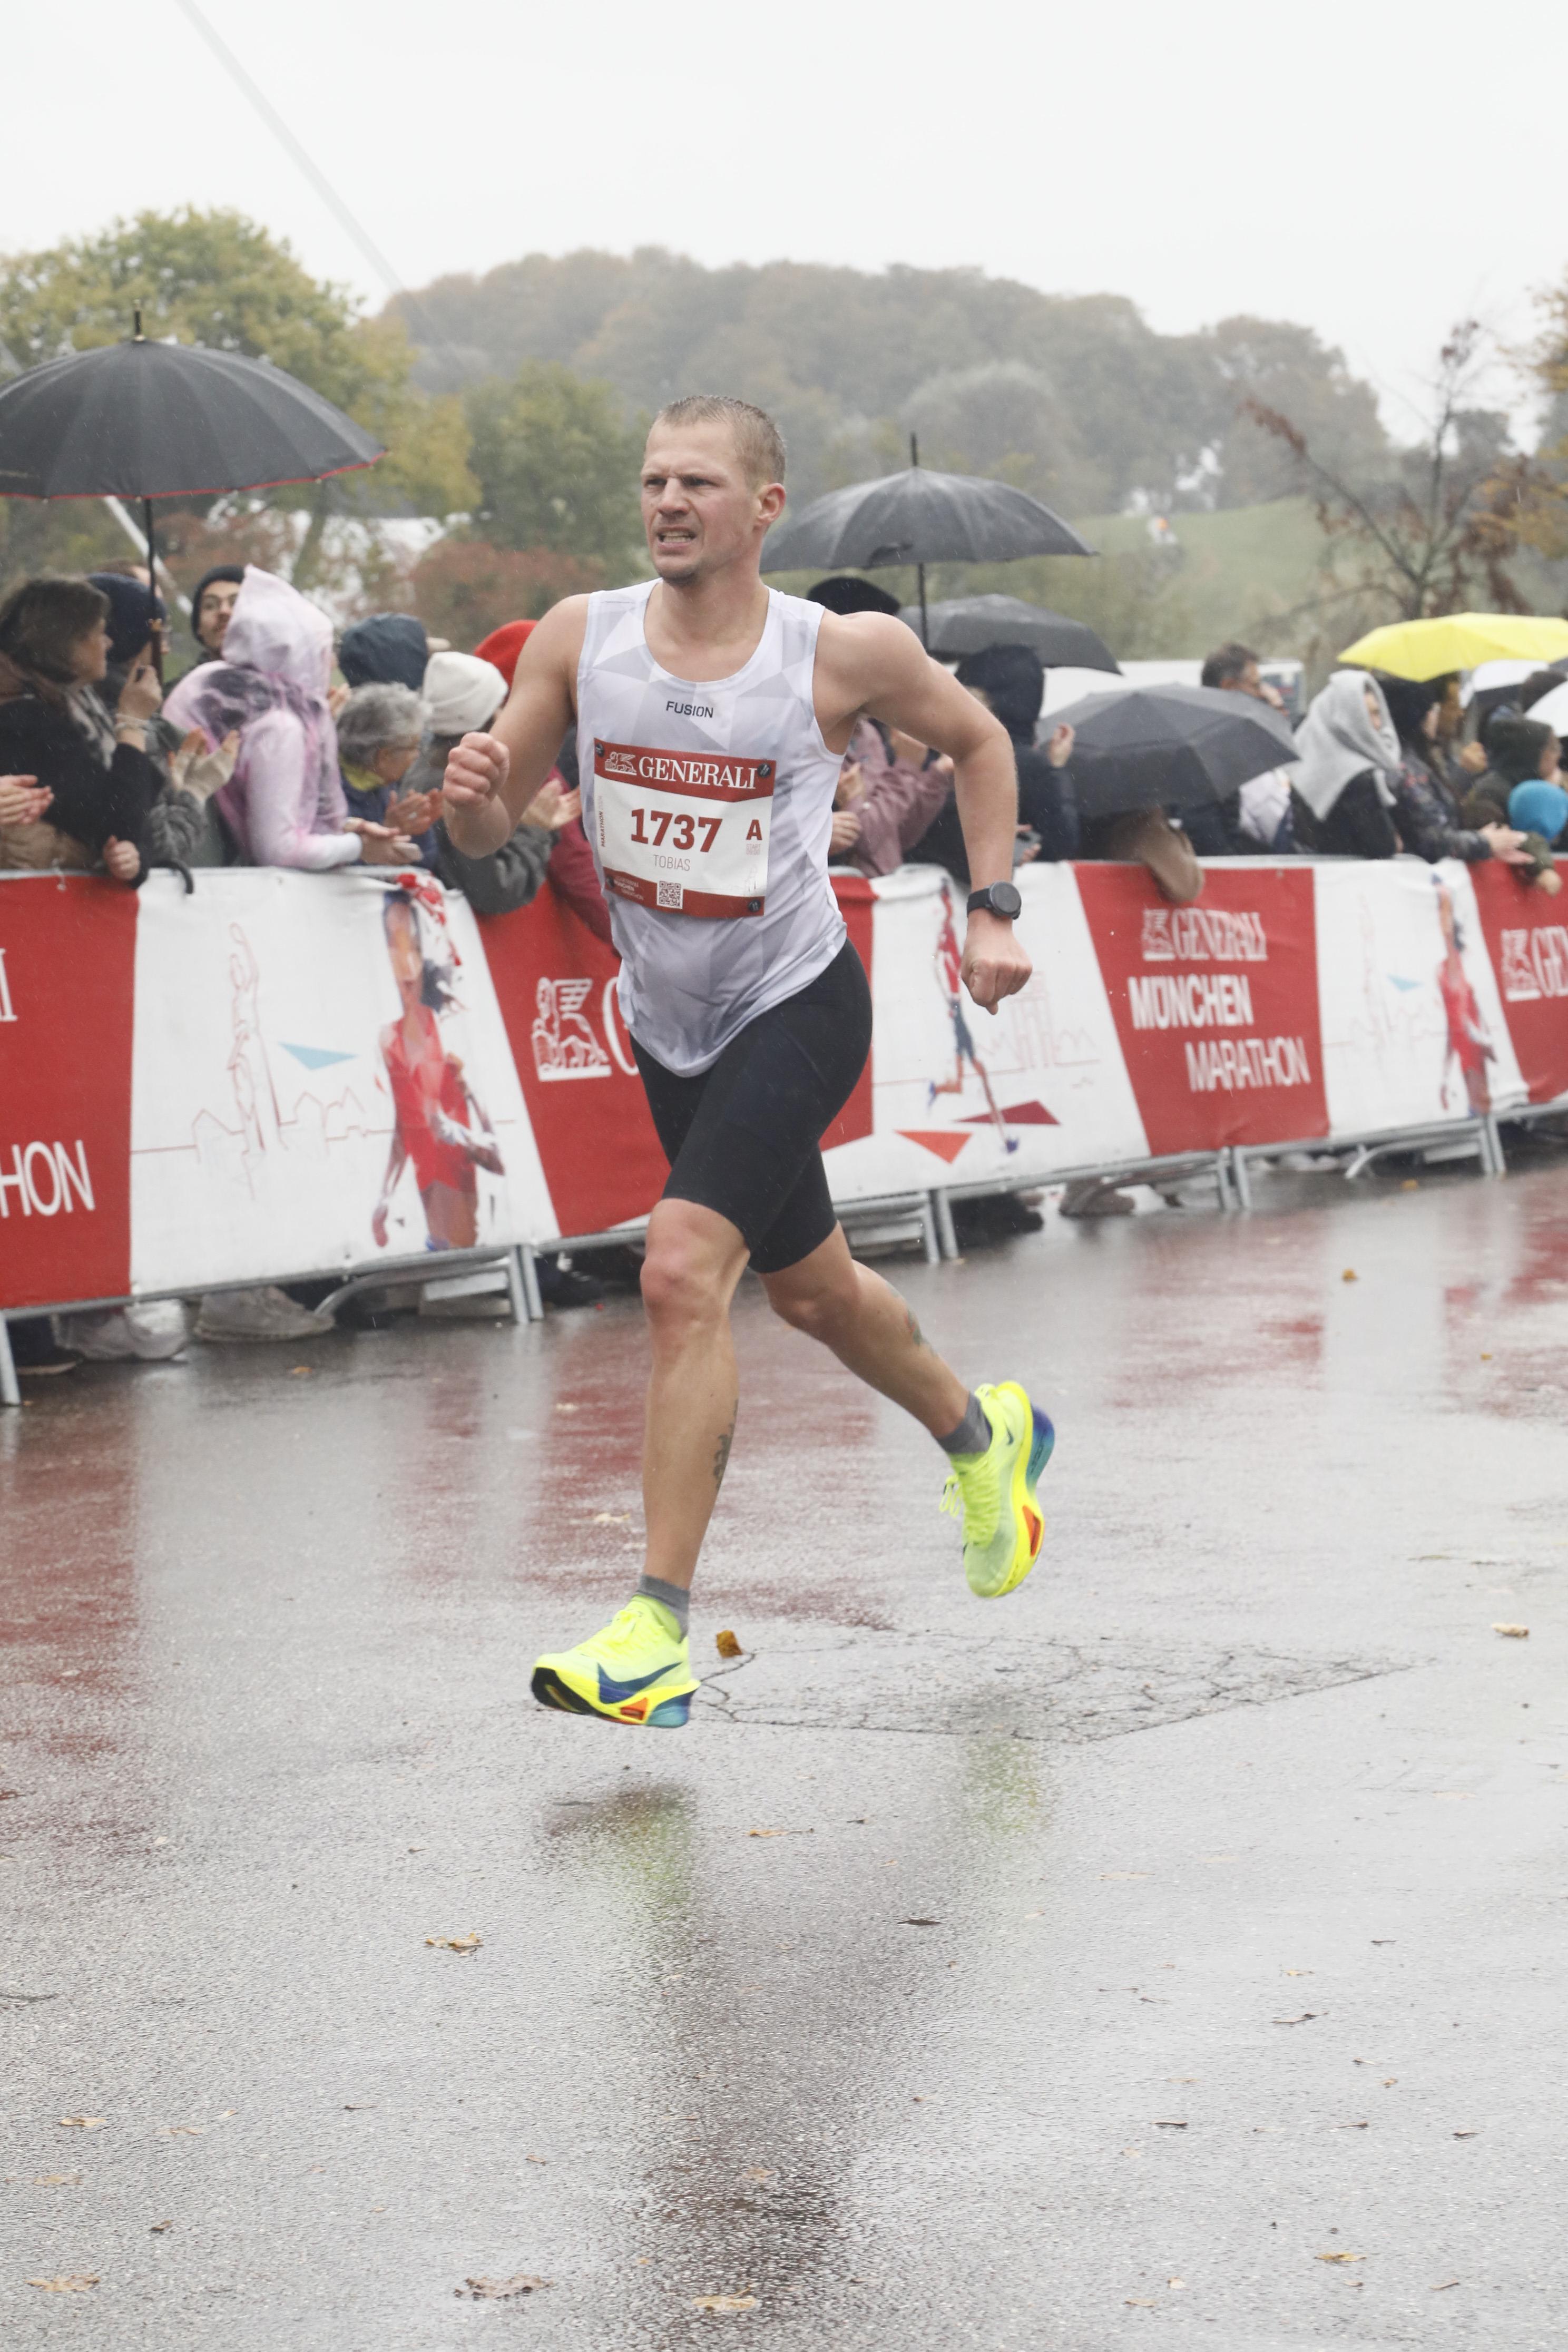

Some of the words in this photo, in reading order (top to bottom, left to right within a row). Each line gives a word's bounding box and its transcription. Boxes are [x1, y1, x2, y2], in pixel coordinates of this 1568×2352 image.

[666, 701, 713, 718] FUSION
[639, 756, 757, 789] GENERALI
[631, 808, 722, 852] 1737
[746, 819, 762, 840] A
[653, 854, 691, 871] TOBIAS
[1184, 1036, 1311, 1093] MARATHON
